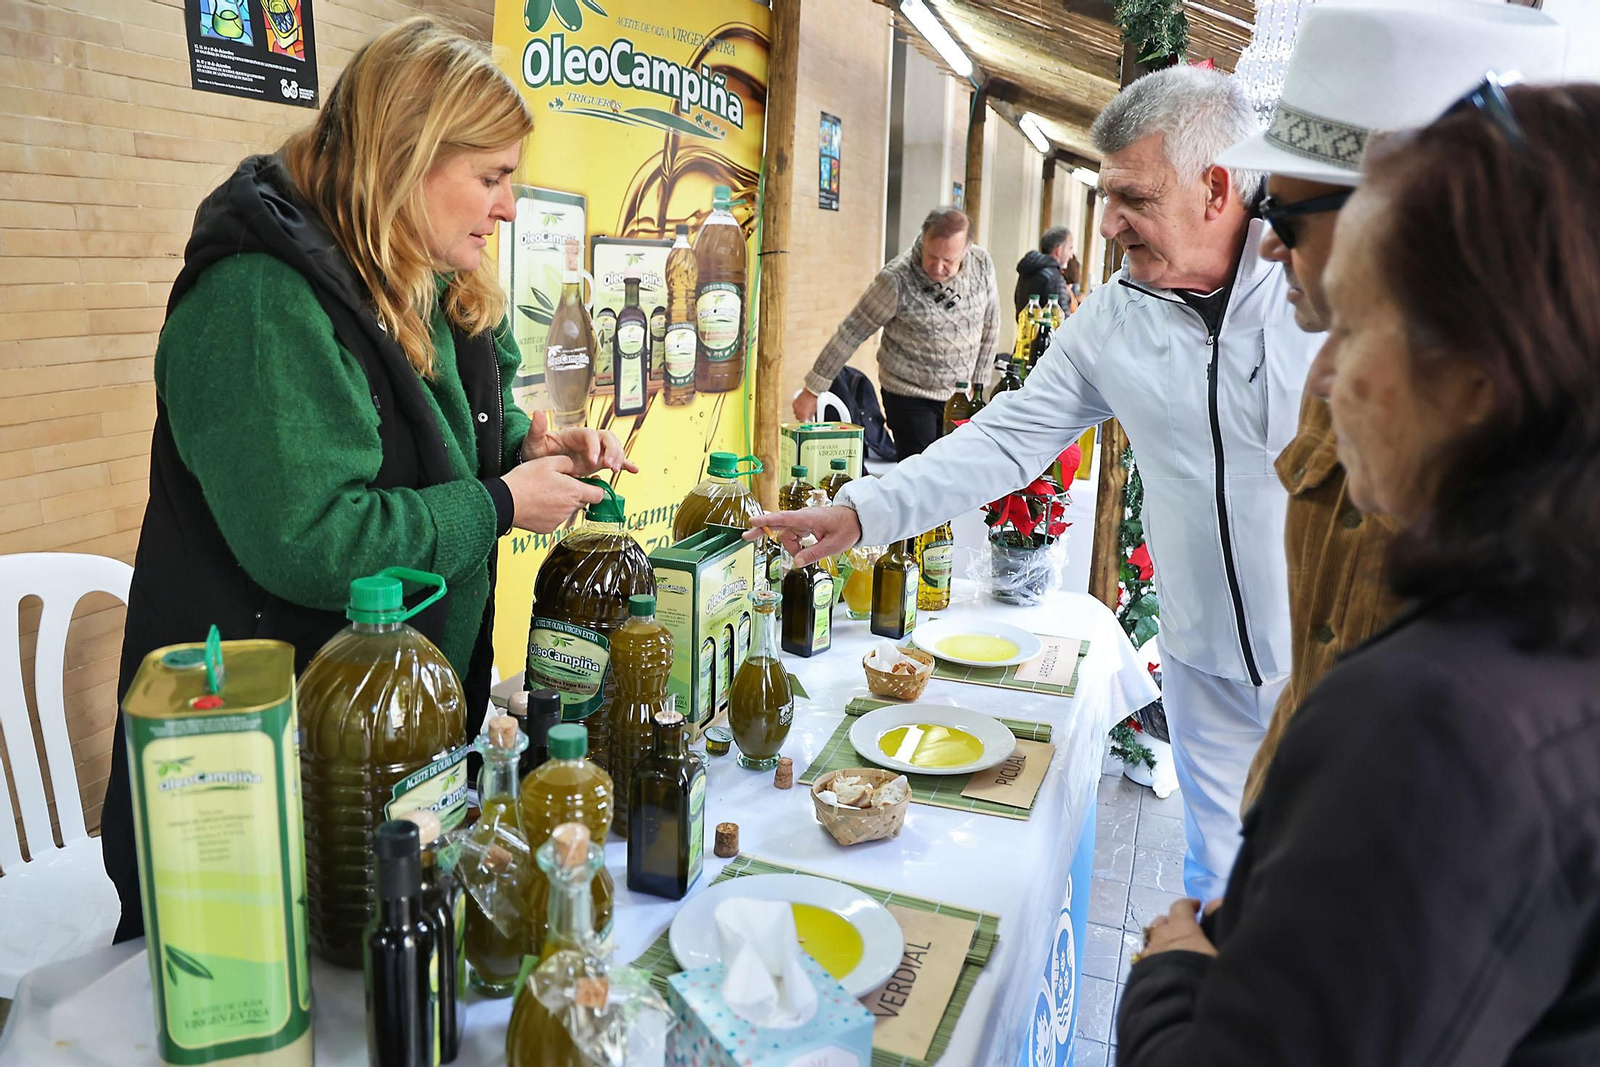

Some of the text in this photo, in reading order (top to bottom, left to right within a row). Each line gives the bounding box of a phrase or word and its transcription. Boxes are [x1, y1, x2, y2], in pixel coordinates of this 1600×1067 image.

[616, 17, 736, 56] ACEITE DE OLIVA VIRGEN EXTRA
[523, 34, 743, 129] OleoCampiña
[566, 92, 622, 110] TRIGUEROS
[552, 622, 564, 632] OLIVA
[564, 624, 582, 637] VIRGEN
[582, 630, 598, 643] EXTRA
[530, 643, 600, 673] OleoCampiña
[159, 769, 262, 791] OleoCampiña
[406, 769, 428, 790] ACEITE
[430, 766, 438, 778] DE
[438, 757, 452, 773] OLIVA
[995, 755, 1027, 787] PICUAL
[873, 941, 932, 1017] VERDIAL
